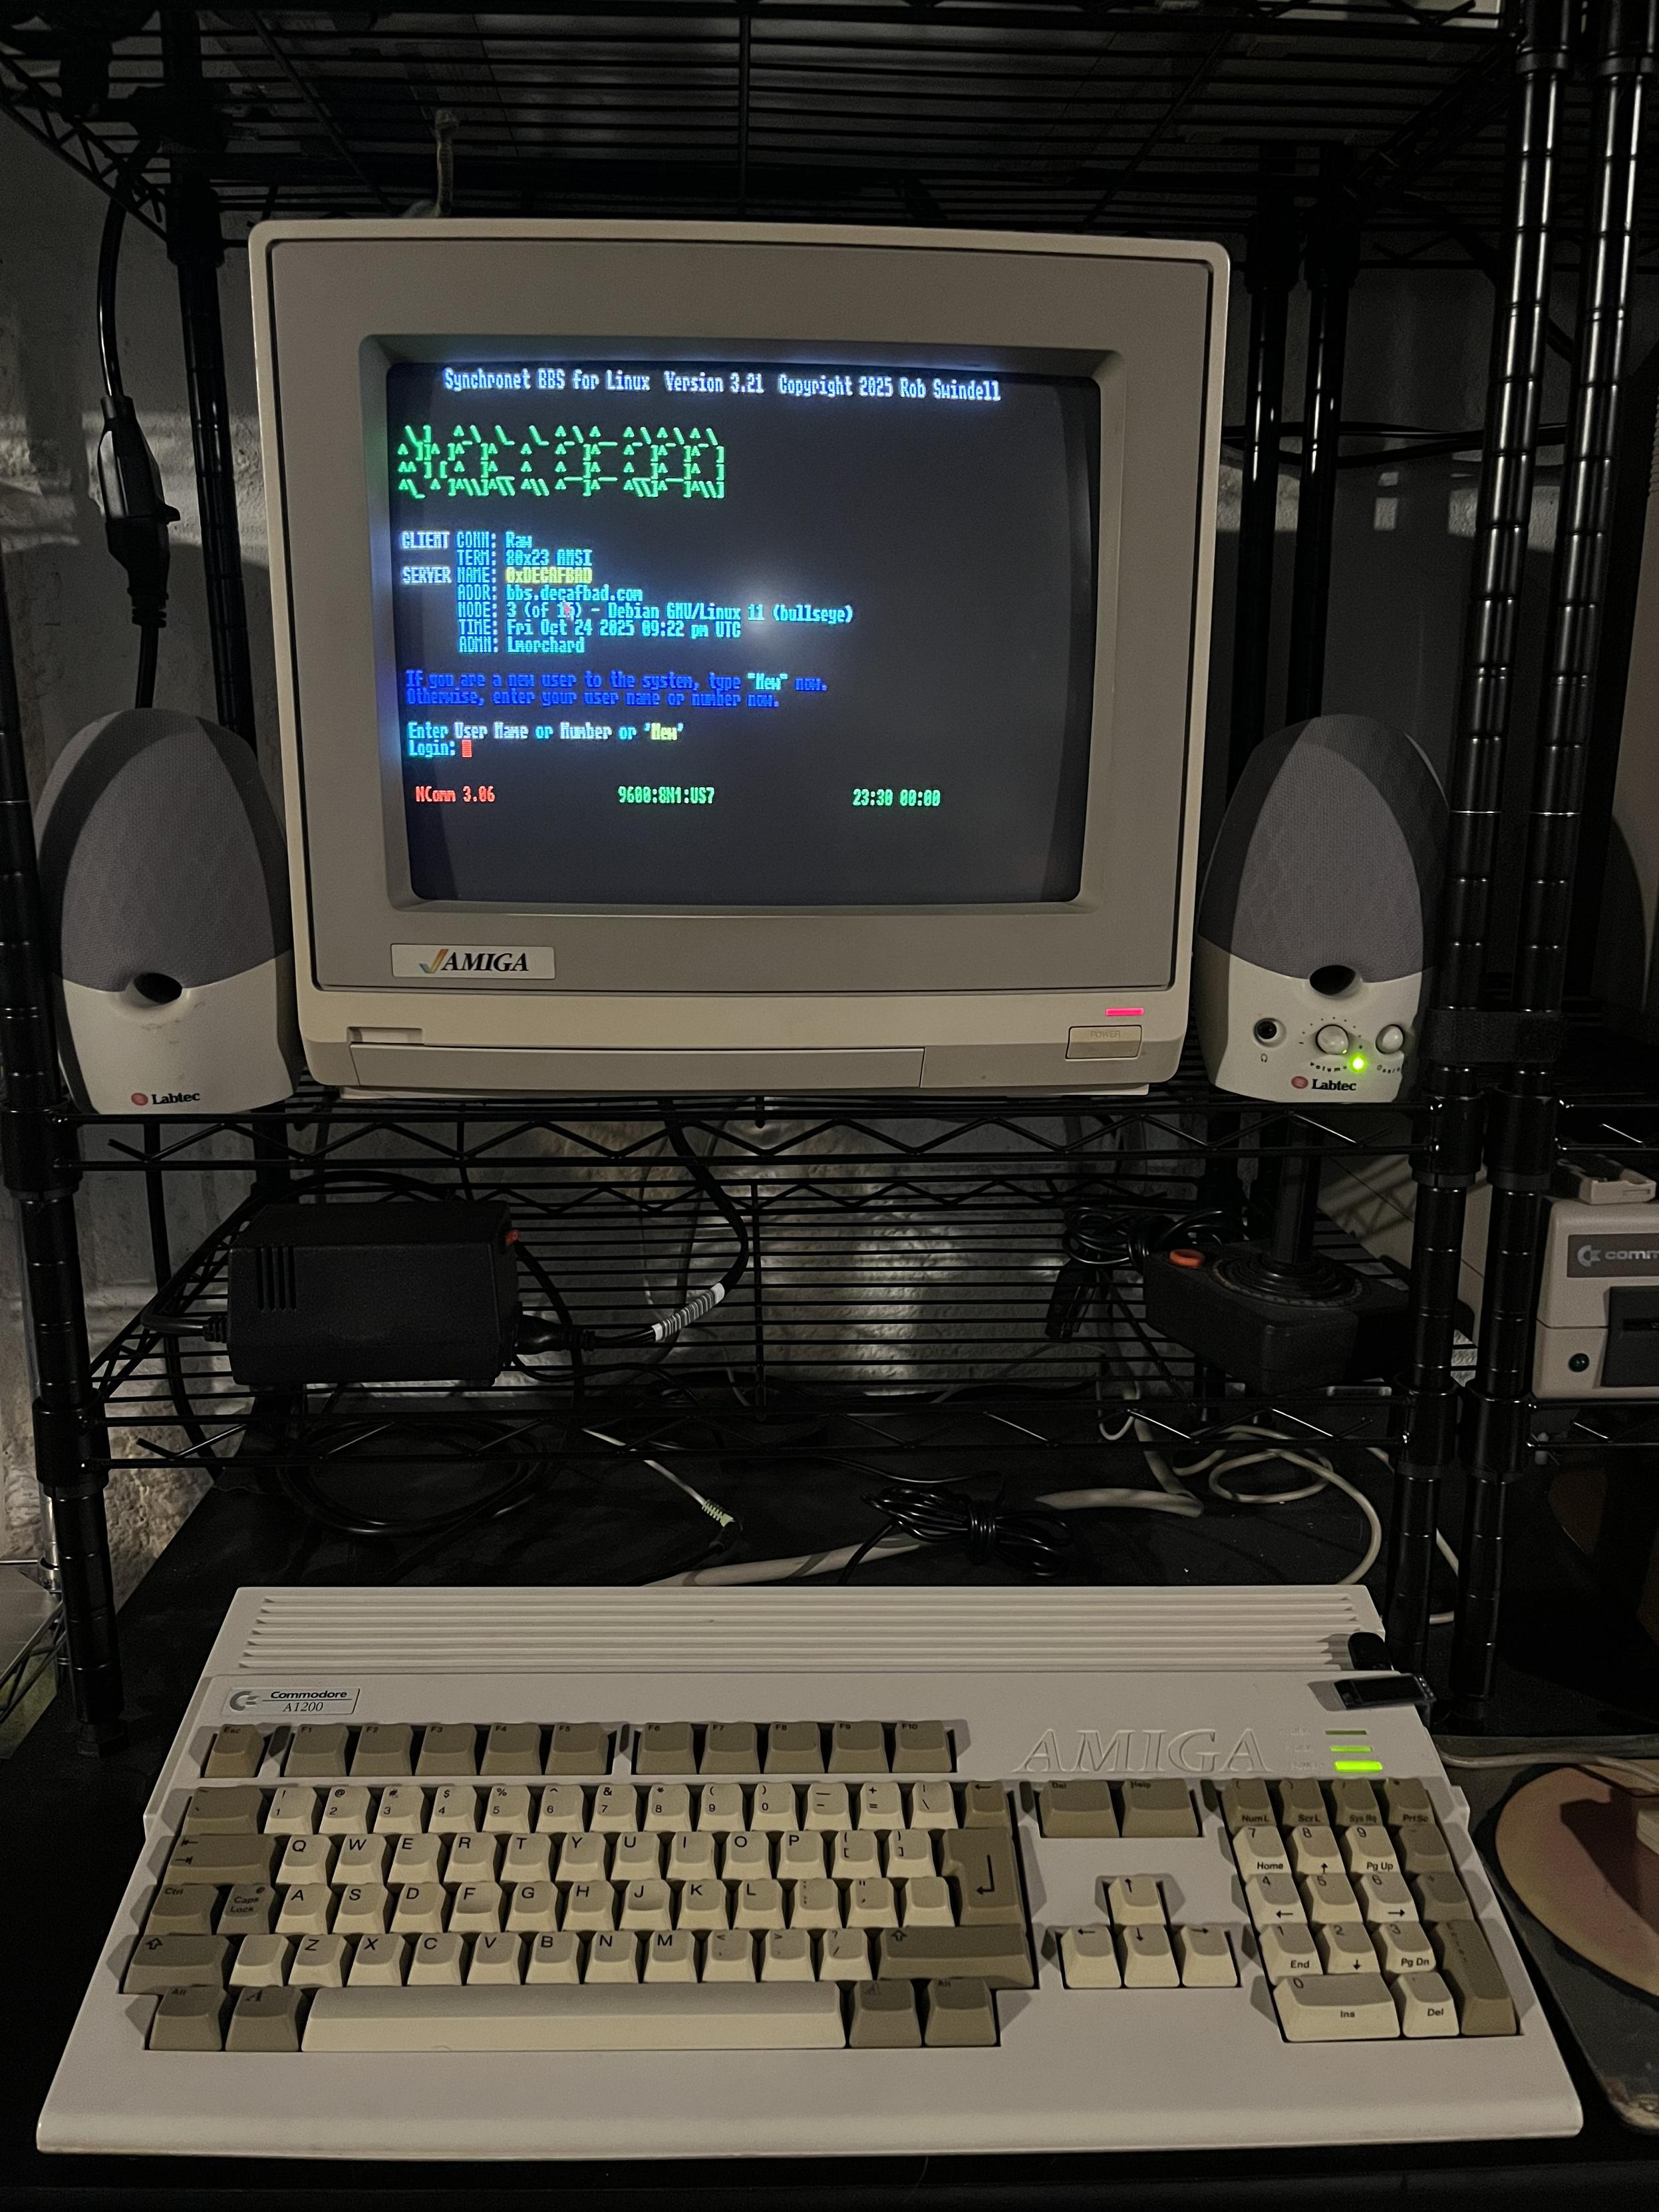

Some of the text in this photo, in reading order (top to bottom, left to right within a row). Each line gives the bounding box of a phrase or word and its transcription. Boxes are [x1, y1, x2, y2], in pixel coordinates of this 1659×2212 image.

[444, 368, 1000, 401] Synchronet BBS for Linux Version 3.21 Copyright 2025 Rob Swindell
[401, 530, 533, 549] CLIENT CONN: Raw
[457, 549, 593, 566] TERM: 80x23 ANSI
[402, 566, 452, 584] SERVER
[457, 567, 496, 583] NAME:
[458, 583, 643, 602] ADDR: bbs.decafbad.com
[458, 601, 497, 618] NODE:
[506, 601, 517, 618] 3
[524, 601, 549, 618] (of
[609, 601, 660, 619] Debian
[666, 603, 740, 621] GNU/Linux
[747, 603, 764, 621] 11
[772, 604, 853, 625] (bullseye)
[459, 619, 741, 639] TIME: Fri Oct 24 2025 09:22 pm UTC
[406, 669, 828, 691] If you are a new user to the system, type "New" now.
[406, 687, 779, 707] Otherwise, enter your user name or number now.
[408, 722, 448, 738] Enter
[454, 722, 488, 739] User
[494, 722, 529, 739] Name
[535, 725, 553, 738] or
[560, 722, 612, 739] Number
[618, 726, 637, 739] or
[408, 740, 456, 757] Login:
[416, 786, 495, 802] NComm 3.06
[853, 788, 941, 806] 23:30 00:00
[440, 952, 529, 971] AMIGA
[1312, 1078, 1356, 1091] Labtec
[151, 1092, 200, 1104] Labtec
[270, 1690, 347, 1699] Commodore
[282, 1702, 323, 1712] A1200
[1012, 1728, 1275, 1773] AMIGA
[383, 1806, 391, 1815] 3
[493, 1806, 500, 1814] 5
[547, 1805, 554, 1814] 6
[601, 1804, 609, 1813] 7
[708, 1804, 716, 1812] 9
[762, 1802, 769, 1811] 0
[1248, 1827, 1256, 1838] 7
[1302, 1827, 1312, 1838] 8
[1356, 1827, 1367, 1837] 9
[293, 1840, 306, 1853] Q
[349, 1839, 367, 1851] W
[402, 1838, 413, 1849] E
[458, 1837, 471, 1849] R
[516, 1837, 527, 1849] T
[571, 1837, 583, 1848] Y
[624, 1836, 637, 1848] U
[682, 1836, 686, 1848] I
[734, 1835, 748, 1847] O
[789, 1835, 800, 1846] P
[1367, 1861, 1394, 1871] Pg Up
[1262, 1875, 1271, 1886] 4
[1316, 1875, 1326, 1886] 5
[1372, 1875, 1382, 1885] 6
[291, 1889, 304, 1901] A
[349, 1889, 361, 1900] S
[406, 1888, 419, 1899] D
[464, 1887, 476, 1899] F
[522, 1887, 534, 1899] G
[576, 1885, 589, 1897] H
[634, 1885, 644, 1897] J
[690, 1884, 702, 1896] K
[747, 1883, 756, 1895] L
[230, 1905, 253, 1913] Lock
[1277, 1925, 1285, 1936] 1
[1334, 1925, 1344, 1935] 2
[1390, 1924, 1401, 1935] 3
[305, 1939, 319, 1951] Z
[364, 1938, 378, 1950] X
[424, 1938, 437, 1949] C
[485, 1937, 497, 1949] V
[541, 1936, 553, 1948] B
[599, 1935, 613, 1947] N
[657, 1935, 673, 1946] M
[1290, 1960, 1310, 1969] End
[1401, 1957, 1430, 1968] Pg Dn
[1293, 1978, 1304, 1988] 0
